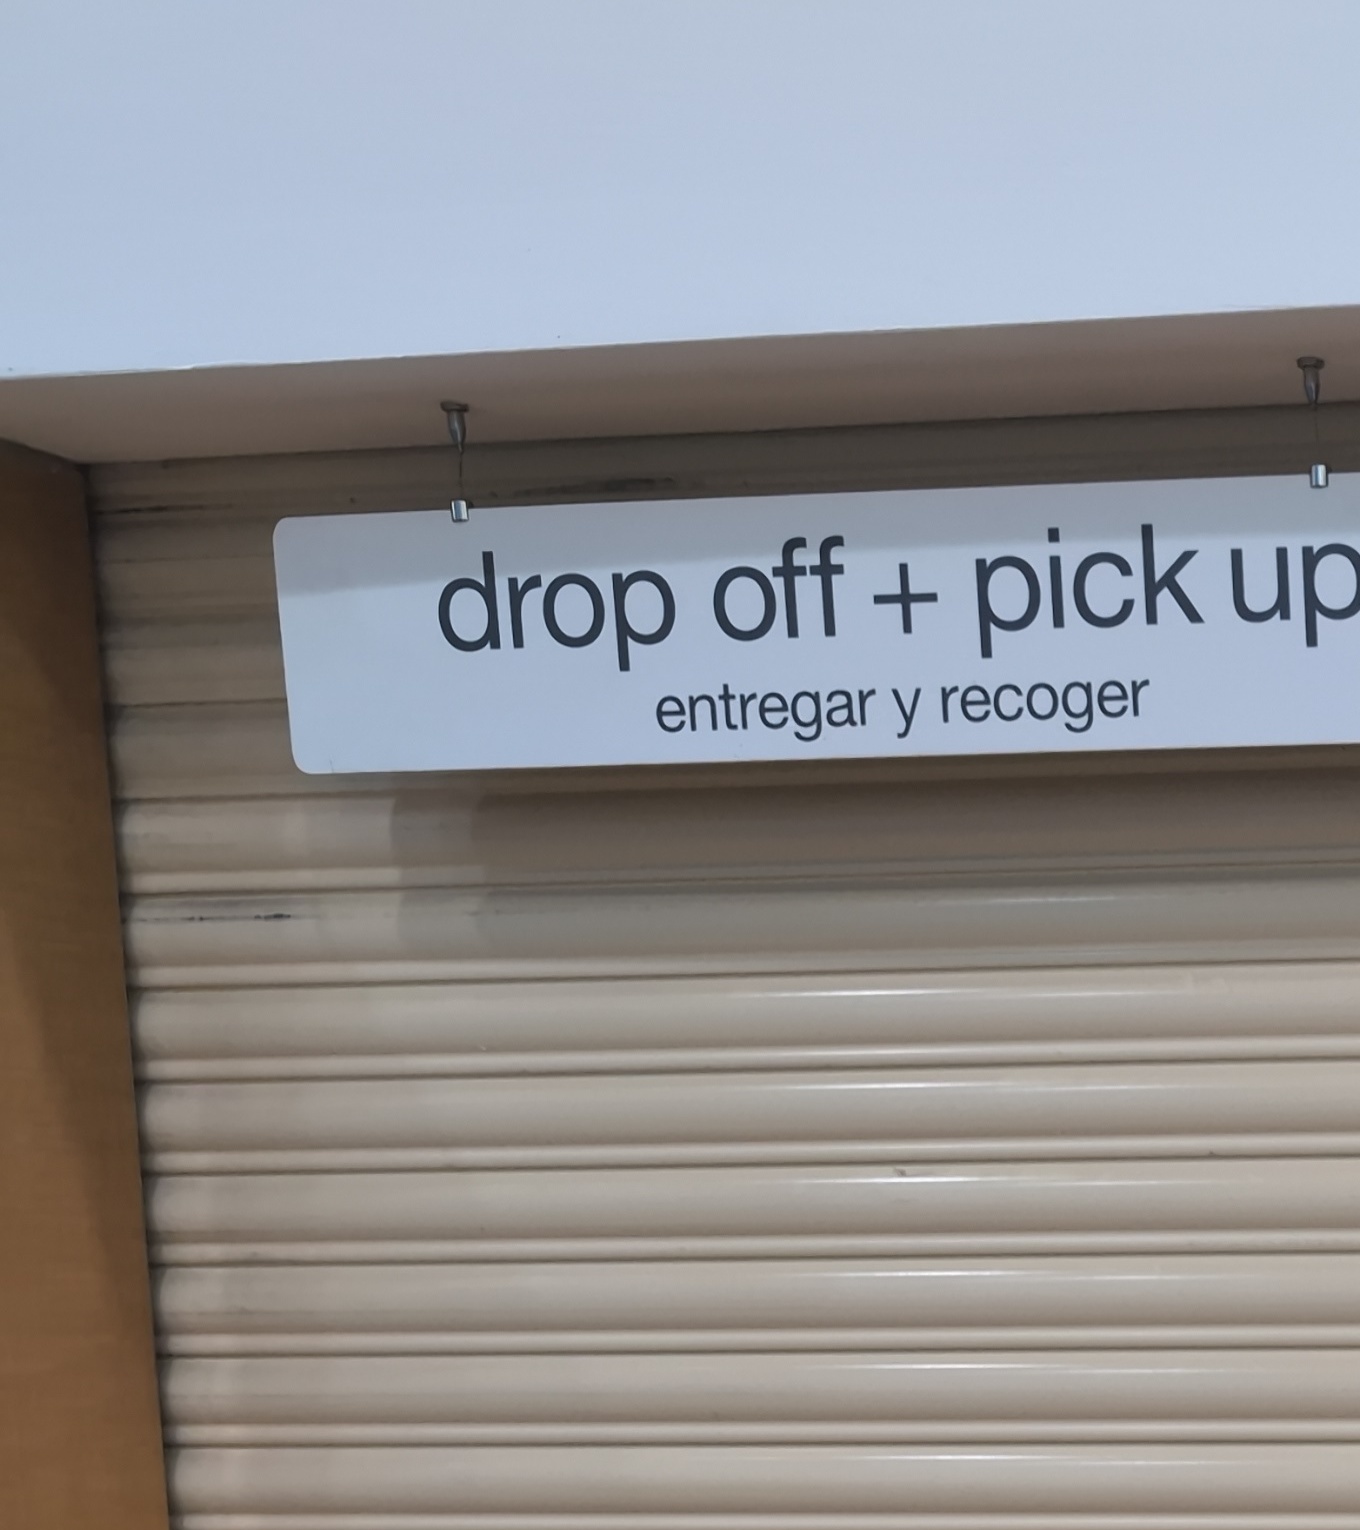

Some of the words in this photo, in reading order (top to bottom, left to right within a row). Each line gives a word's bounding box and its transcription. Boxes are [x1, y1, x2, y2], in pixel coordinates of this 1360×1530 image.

[437, 550, 676, 672] drop
[712, 534, 845, 642] off
[873, 562, 939, 634] +
[975, 523, 1205, 659] pick
[655, 686, 877, 743] entregar
[891, 687, 922, 739] y
[940, 679, 1150, 734] recoger
